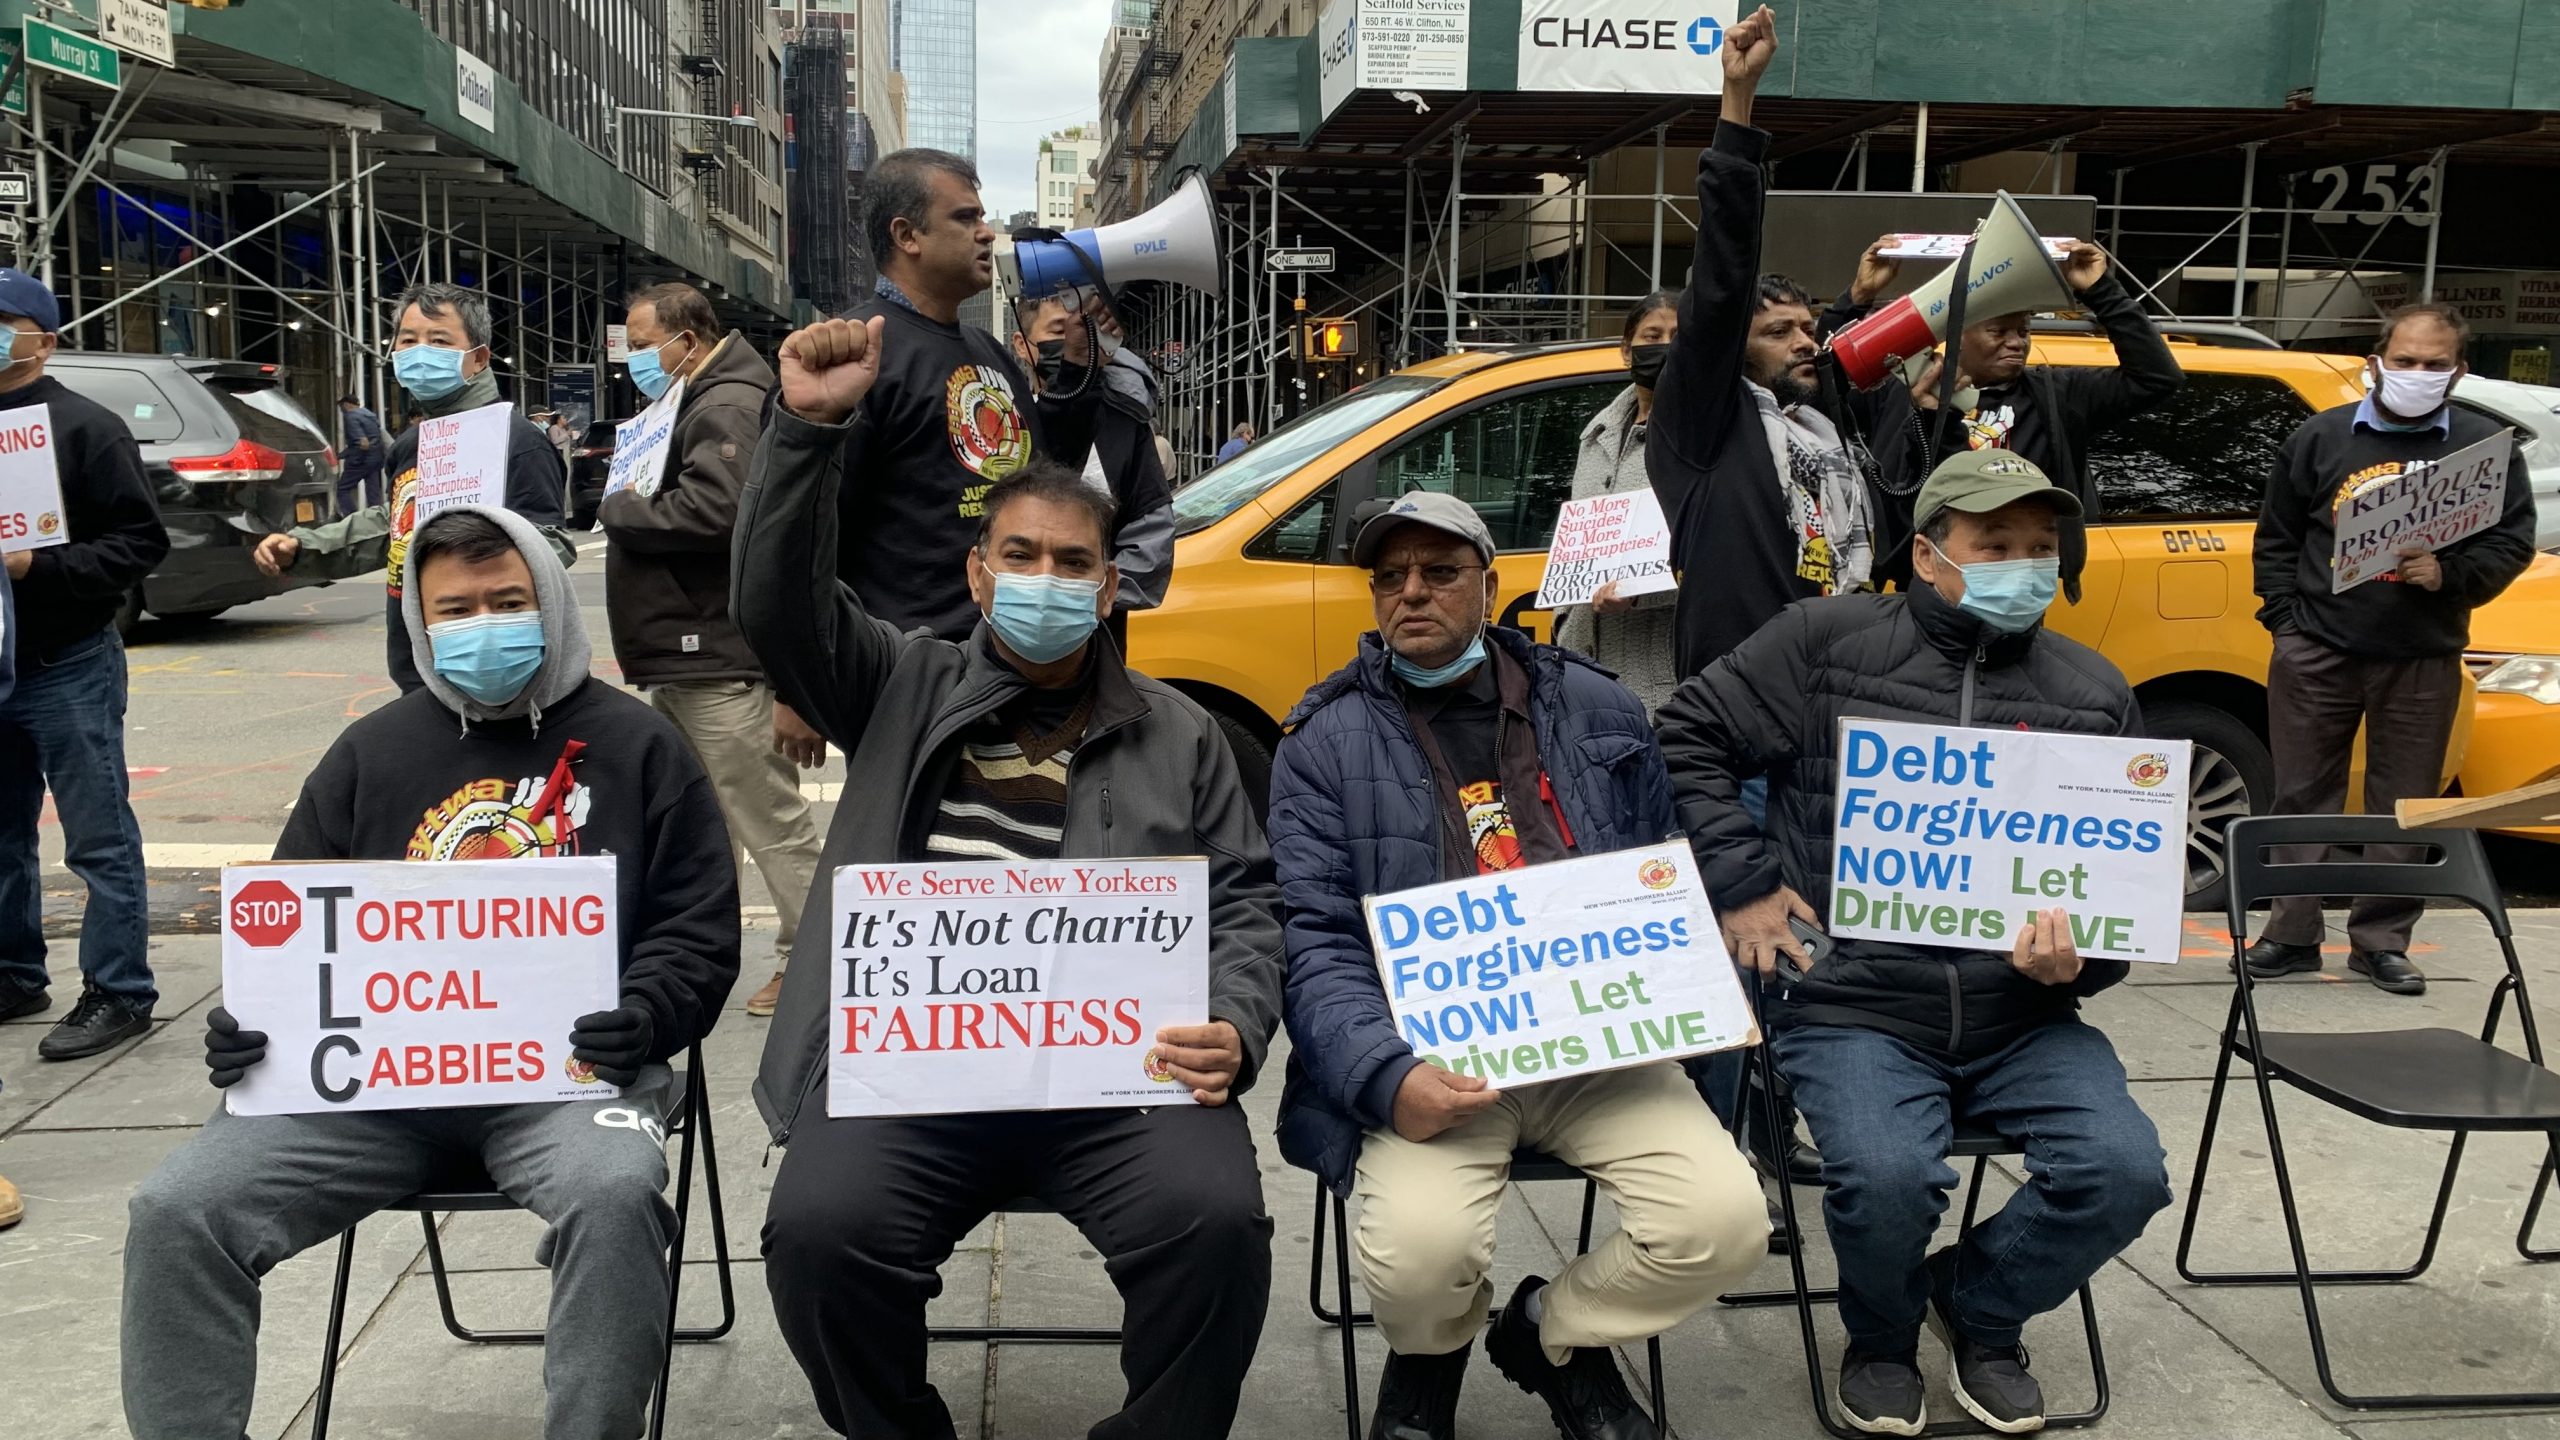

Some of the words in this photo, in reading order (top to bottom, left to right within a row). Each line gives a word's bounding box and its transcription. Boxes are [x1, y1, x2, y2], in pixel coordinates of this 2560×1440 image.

[1365, 17, 1379, 26] 650
[1381, 17, 1392, 27] RT.
[1394, 18, 1404, 27] 46
[1445, 19, 1456, 28] NJ
[1417, 0, 1465, 11] Services
[122, 23, 167, 54] MON-FRI
[1362, 32, 1410, 42] 973-591-0220
[1416, 33, 1464, 43] 201-250-0850
[1533, 17, 1678, 50] CHASE
[51, 36, 87, 73] Murray
[90, 49, 100, 72] St
[1322, 28, 1347, 80] CHASE
[460, 63, 492, 113] Citibank
[0, 182, 20, 194] AY
[2312, 164, 2437, 227] 253
[1274, 255, 1295, 265] ONE
[1306, 255, 1328, 265] WAY
[1506, 277, 1540, 306] CHSE
[421, 423, 434, 443] No
[436, 420, 460, 438] More
[610, 421, 669, 477] Forgiveness
[616, 414, 648, 452] Debt
[419, 440, 457, 462] Suicides
[417, 469, 483, 499] Bankruptcies!
[419, 462, 433, 480] No
[433, 459, 457, 479] More
[635, 457, 651, 483] Let
[2410, 457, 2494, 510] YOUR
[1564, 503, 1586, 519] No
[1590, 497, 1630, 515] More
[2352, 464, 2440, 518] KEEP
[1559, 509, 1629, 534] Suicides!
[2341, 473, 2502, 557] PROMISES!
[2422, 506, 2495, 548] NOW!
[1551, 531, 1661, 564] Bankruptcies!
[1555, 533, 1576, 549] No
[1580, 528, 1622, 546] More
[2338, 545, 2379, 572] Debt
[2385, 499, 2489, 551] Forgiveness
[1543, 559, 1672, 592] FORGIVENESS
[1547, 558, 1598, 577] DEBT
[1539, 585, 1592, 606] NOW!
[1846, 729, 1996, 789] Debt
[405, 778, 506, 861] ytwa
[1840, 788, 2163, 853] Forgiveness
[859, 870, 911, 897] We
[921, 869, 995, 896] Serve
[1004, 868, 1065, 894] New
[1073, 867, 1177, 894] Yorkers
[1838, 845, 1972, 893] NOW!
[2011, 857, 2088, 900] Let
[235, 901, 298, 928] STOP
[1376, 884, 1526, 950] Debt
[1600, 900, 1618, 908] YORK
[1618, 897, 1633, 905] TAXI
[1634, 893, 1665, 902] WORKERS
[1834, 887, 2006, 940] Drivers
[841, 909, 916, 949] It's
[928, 910, 1012, 947] Not
[1025, 906, 1194, 953] Charity
[1393, 916, 1692, 999] Forgiveness
[926, 955, 1041, 996] Loan
[840, 998, 1142, 1054] FAIRNESS
[1402, 990, 1540, 1050] NOW!
[1569, 970, 1652, 1016] Let
[1602, 1010, 1726, 1060] LIVE.
